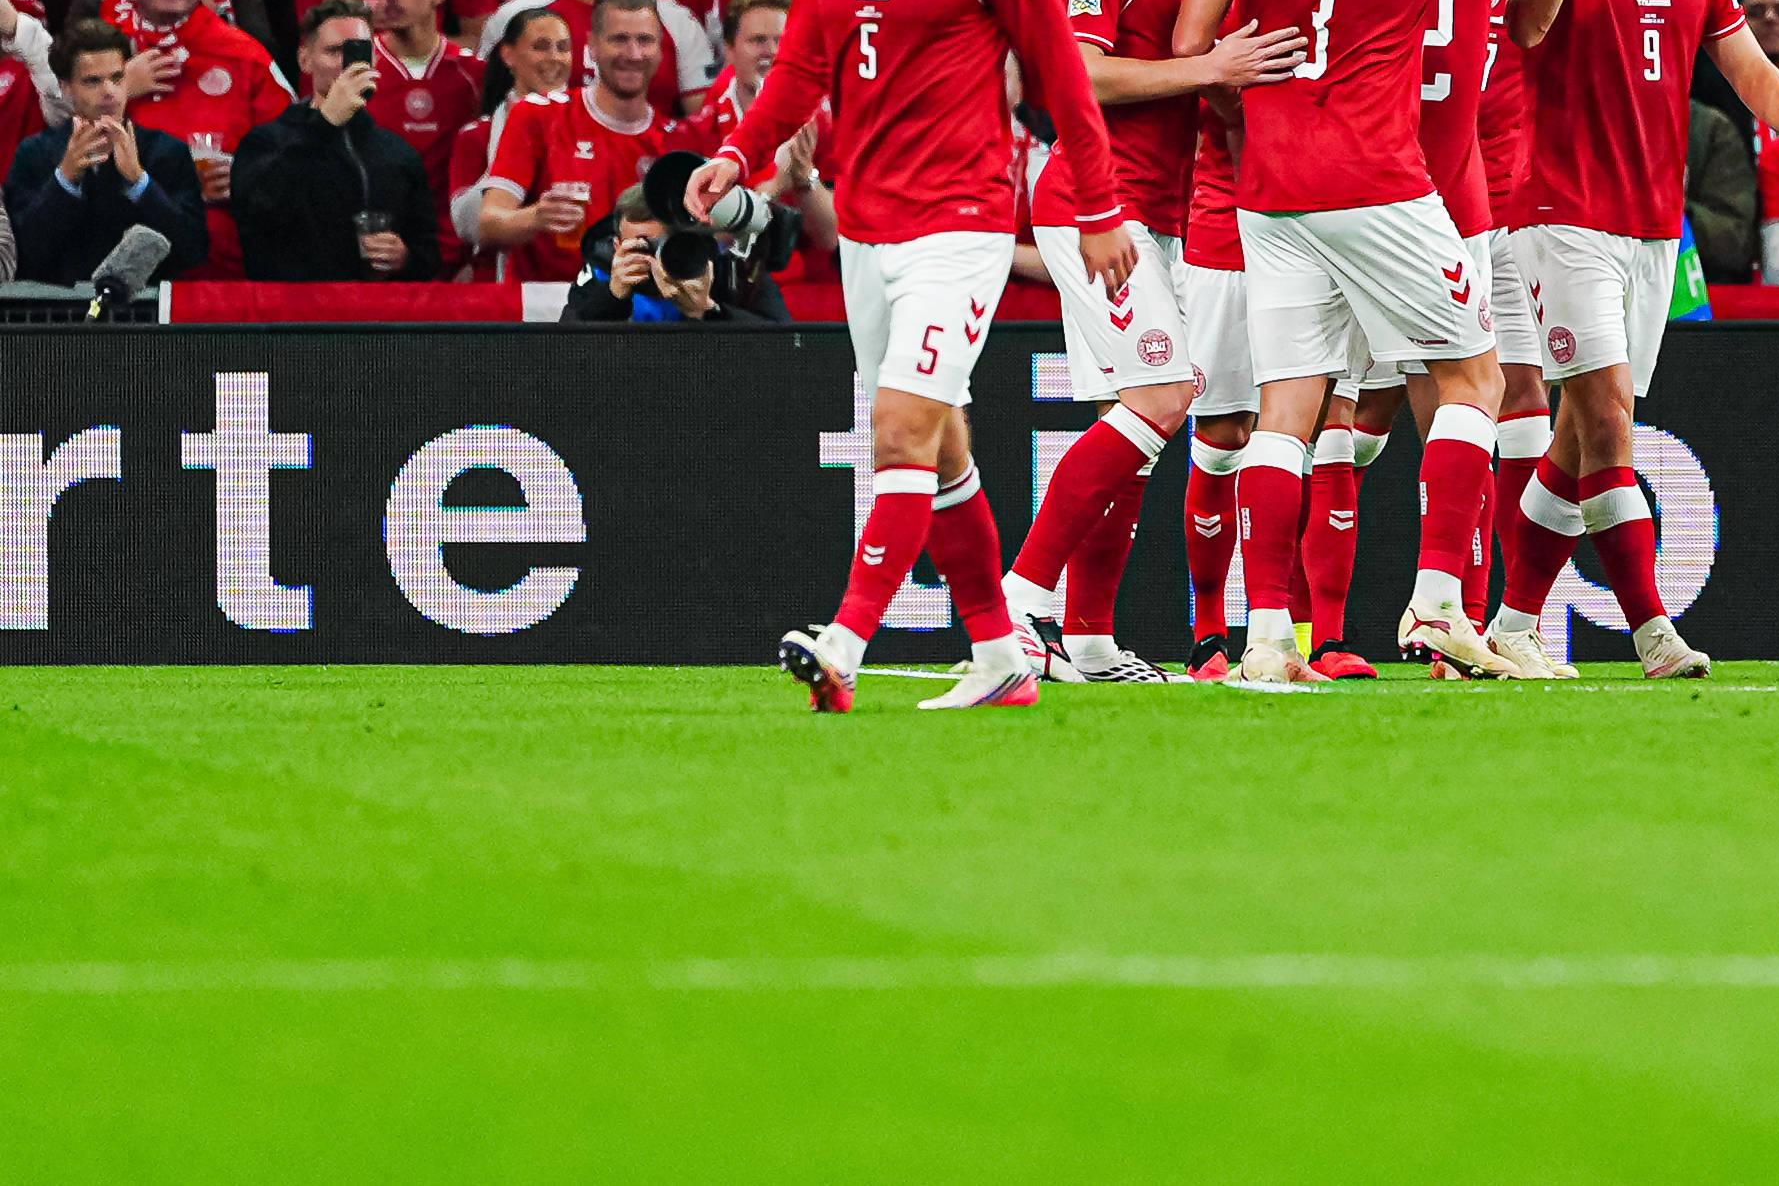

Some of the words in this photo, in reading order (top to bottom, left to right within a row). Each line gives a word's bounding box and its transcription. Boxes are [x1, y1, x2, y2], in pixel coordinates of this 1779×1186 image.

[858, 22, 879, 80] 5
[1643, 29, 1661, 81] 9
[916, 324, 944, 375] 5
[0, 371, 587, 635] rte
